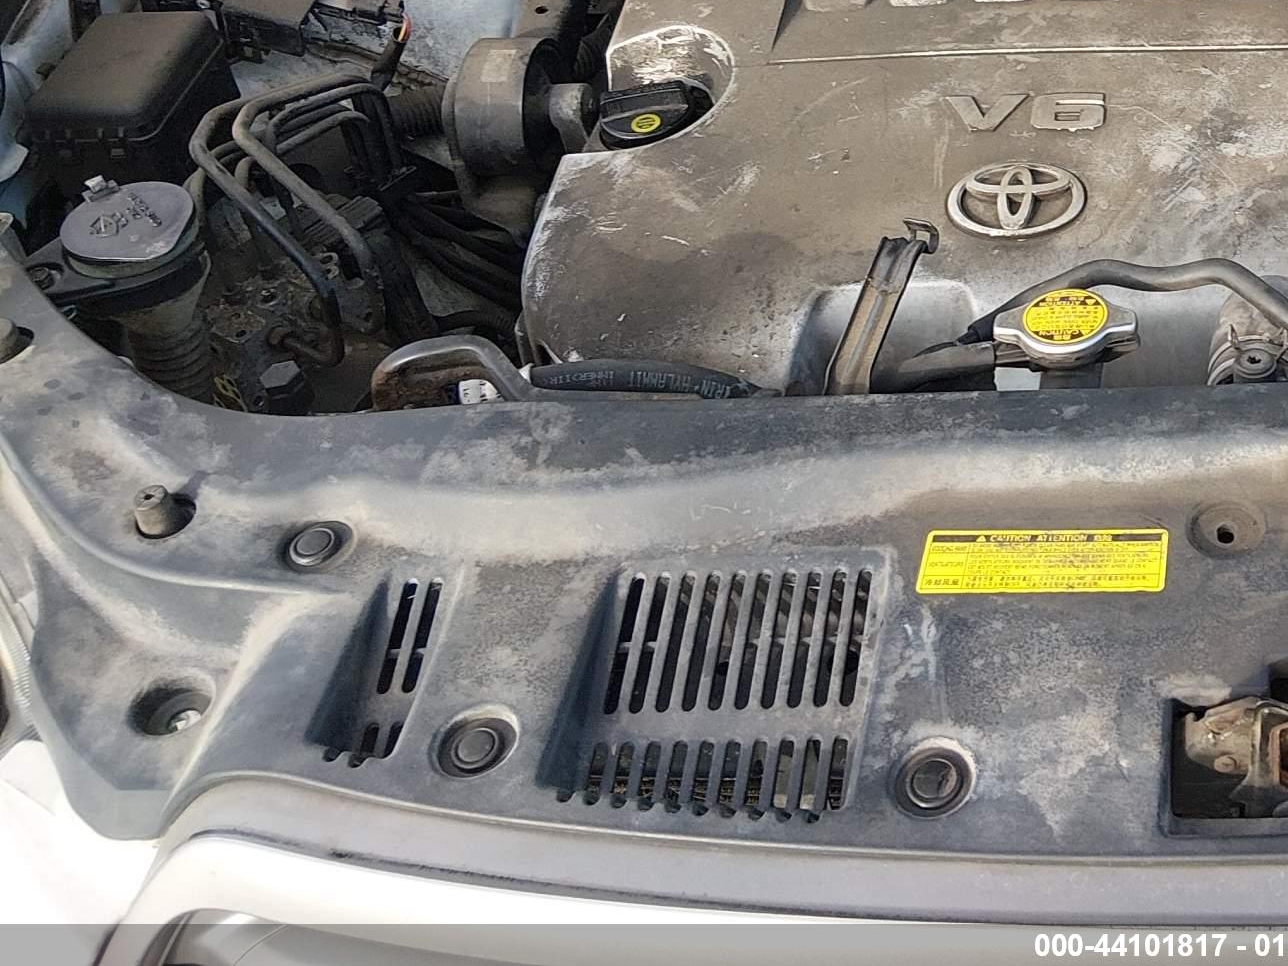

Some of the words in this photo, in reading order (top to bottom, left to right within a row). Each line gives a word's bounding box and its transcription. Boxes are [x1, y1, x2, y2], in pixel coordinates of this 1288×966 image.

[945, 91, 1107, 132] V6
[989, 534, 1031, 542] CAUTION
[1036, 534, 1088, 542] ATTENTION
